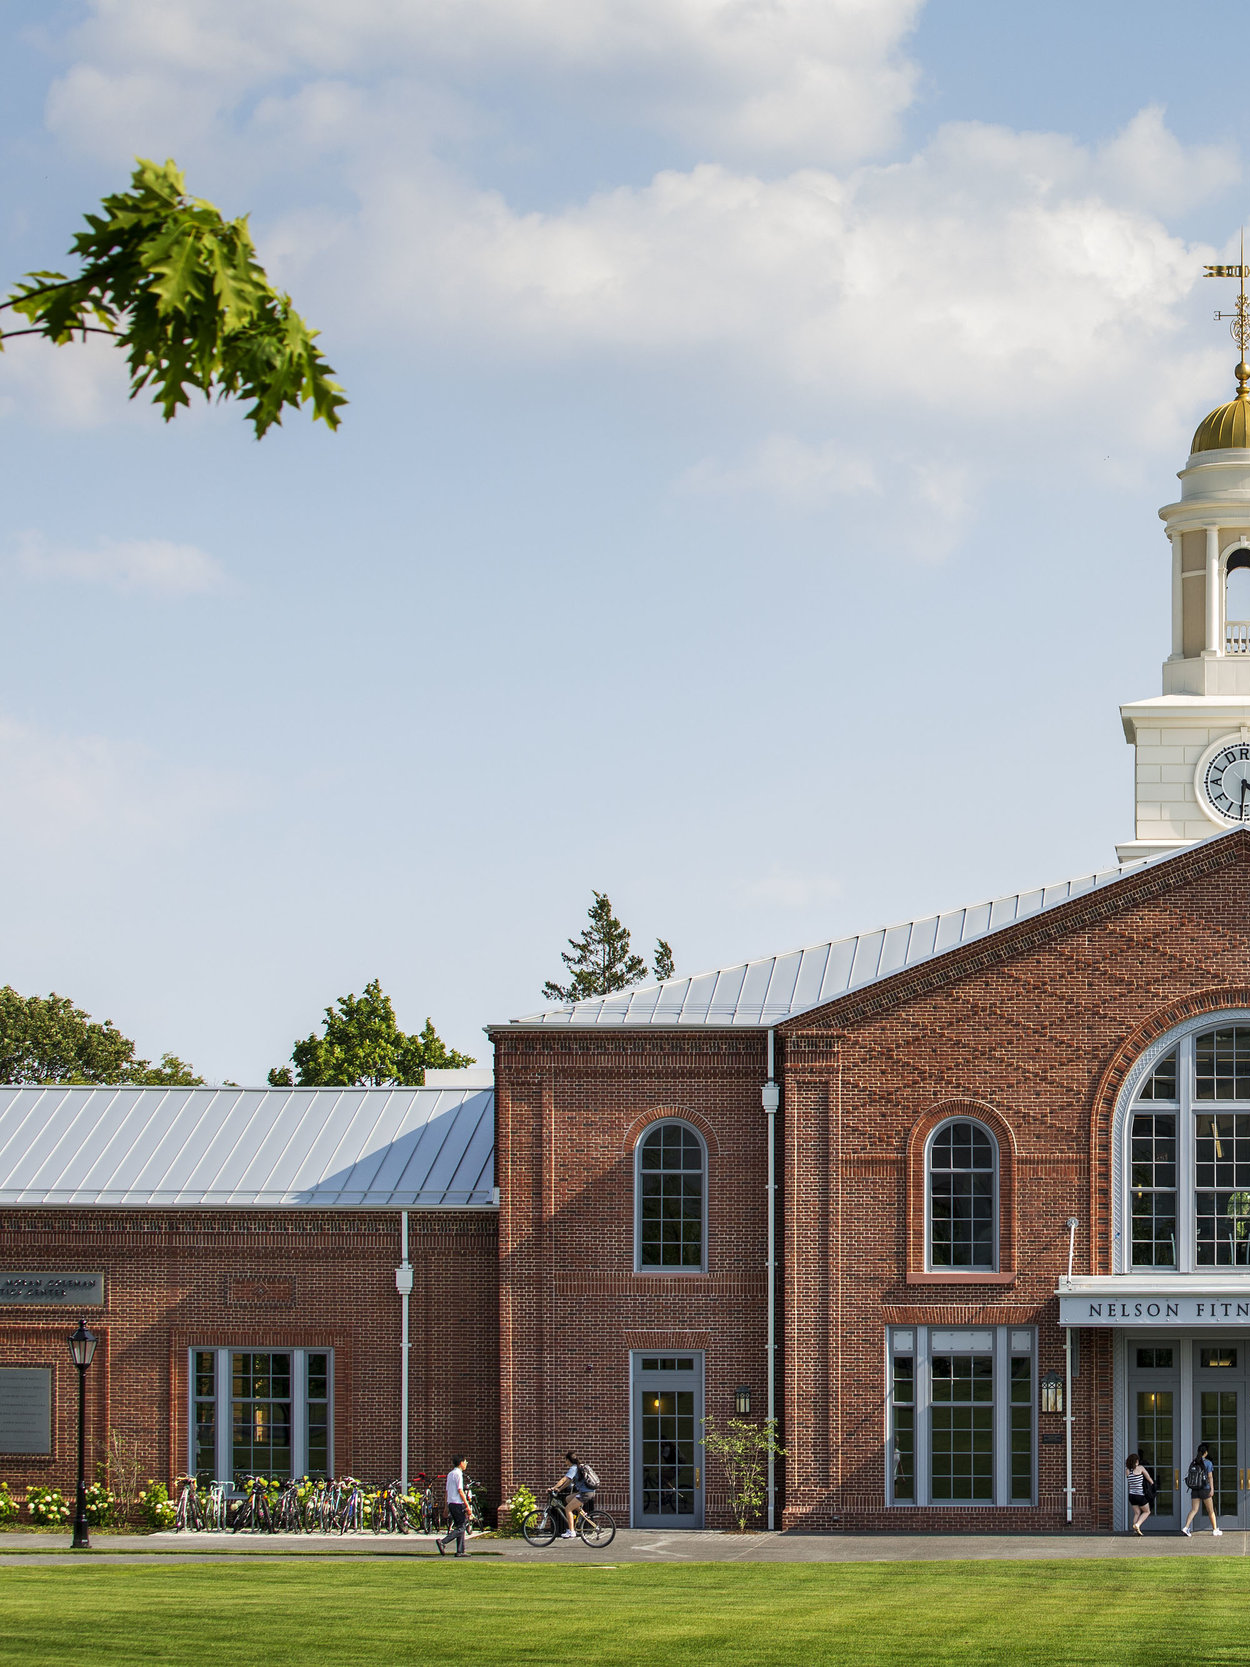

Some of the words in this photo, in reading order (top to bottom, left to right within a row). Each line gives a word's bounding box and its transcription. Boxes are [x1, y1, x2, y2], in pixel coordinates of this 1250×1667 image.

[48, 1279, 96, 1287] COLEMAN
[26, 1288, 67, 1296] CENTER
[1088, 1303, 1180, 1317] NELSON
